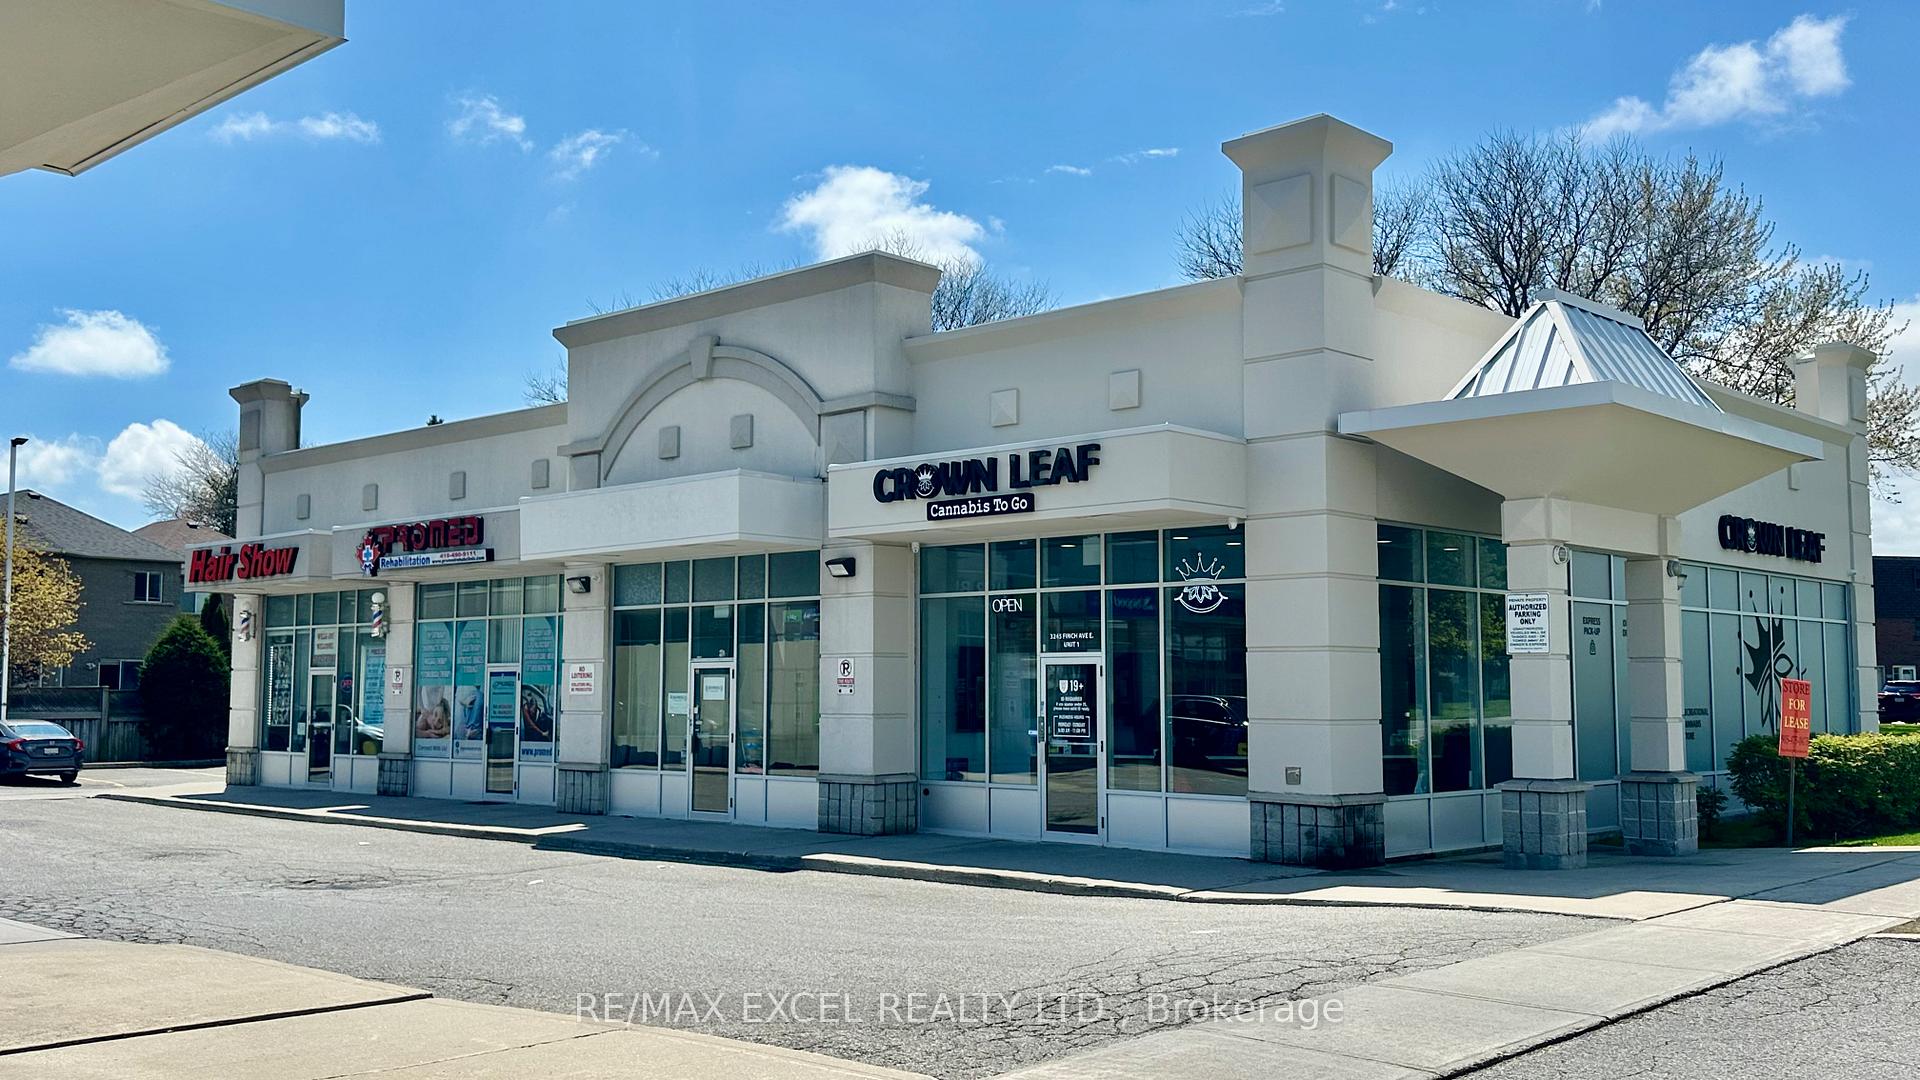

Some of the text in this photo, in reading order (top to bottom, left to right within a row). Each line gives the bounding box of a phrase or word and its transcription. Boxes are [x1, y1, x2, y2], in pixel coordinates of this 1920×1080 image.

[873, 443, 1101, 503] CROWN LEAF
[930, 496, 1028, 518] Cannabis To Go
[1718, 514, 1825, 563] CROWN LEAF
[189, 543, 299, 583] Hair Show
[380, 556, 431, 568] Rehabilitation
[992, 598, 1023, 613] OPEN
[1583, 616, 1601, 625] EXPRESS
[1069, 680, 1084, 692] 19+
[1783, 681, 1810, 695] STORE
[1788, 698, 1806, 711] FOR
[1784, 716, 1809, 730] LEASE
